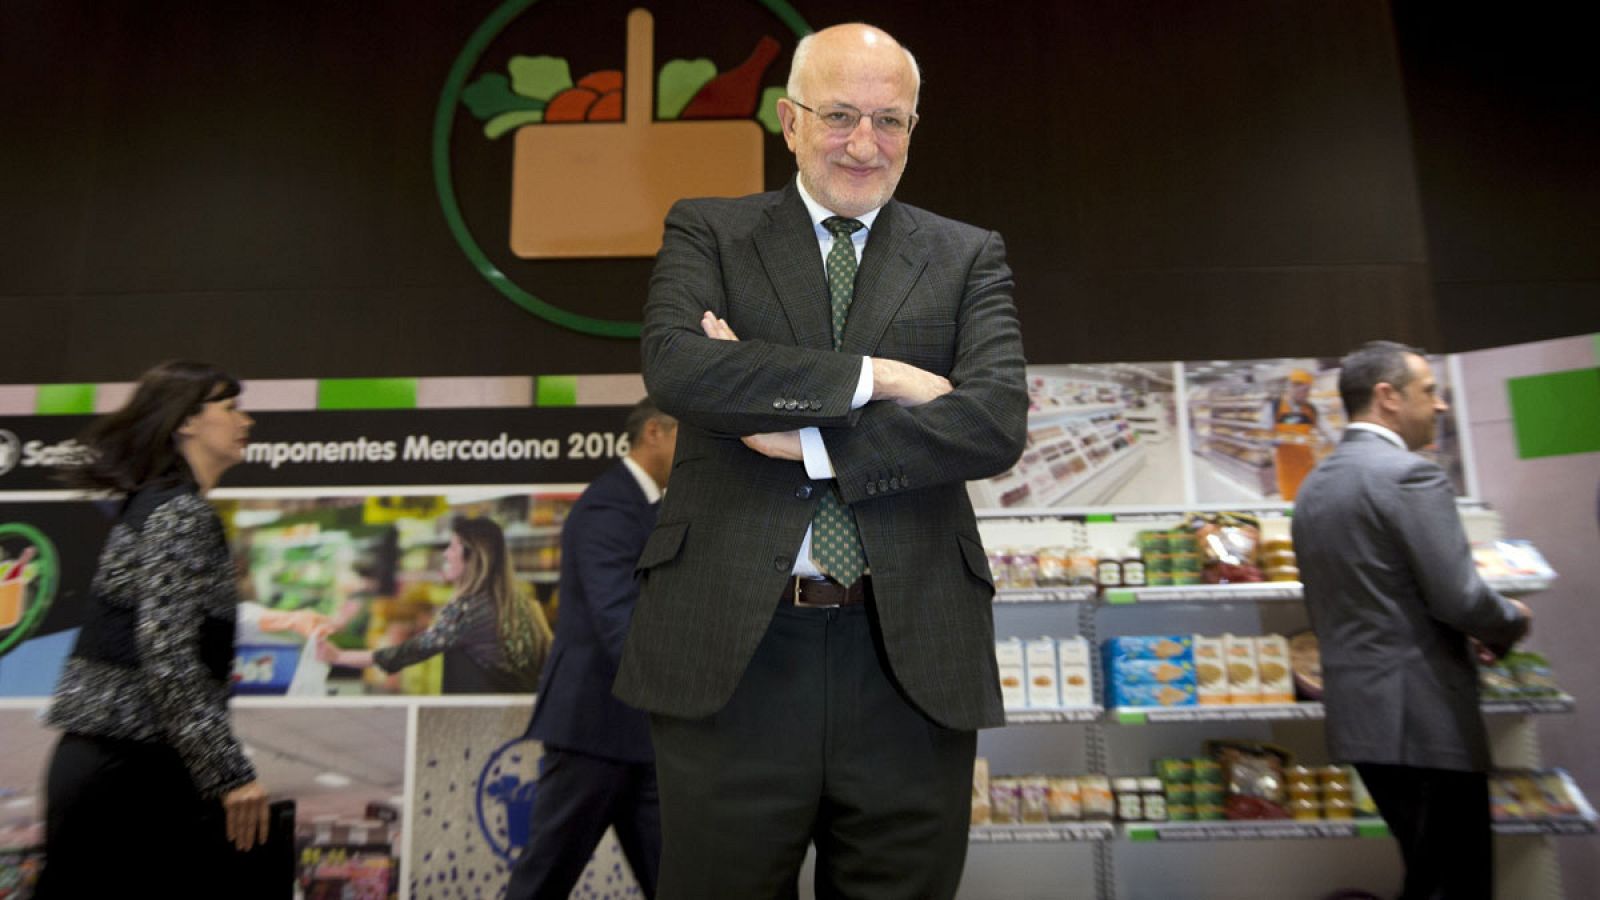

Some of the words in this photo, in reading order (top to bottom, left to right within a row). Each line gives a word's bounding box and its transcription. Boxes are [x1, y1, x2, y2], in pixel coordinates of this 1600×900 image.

[241, 440, 396, 468] mponentes
[402, 433, 559, 460] Mercadona
[567, 432, 630, 459] 2016
